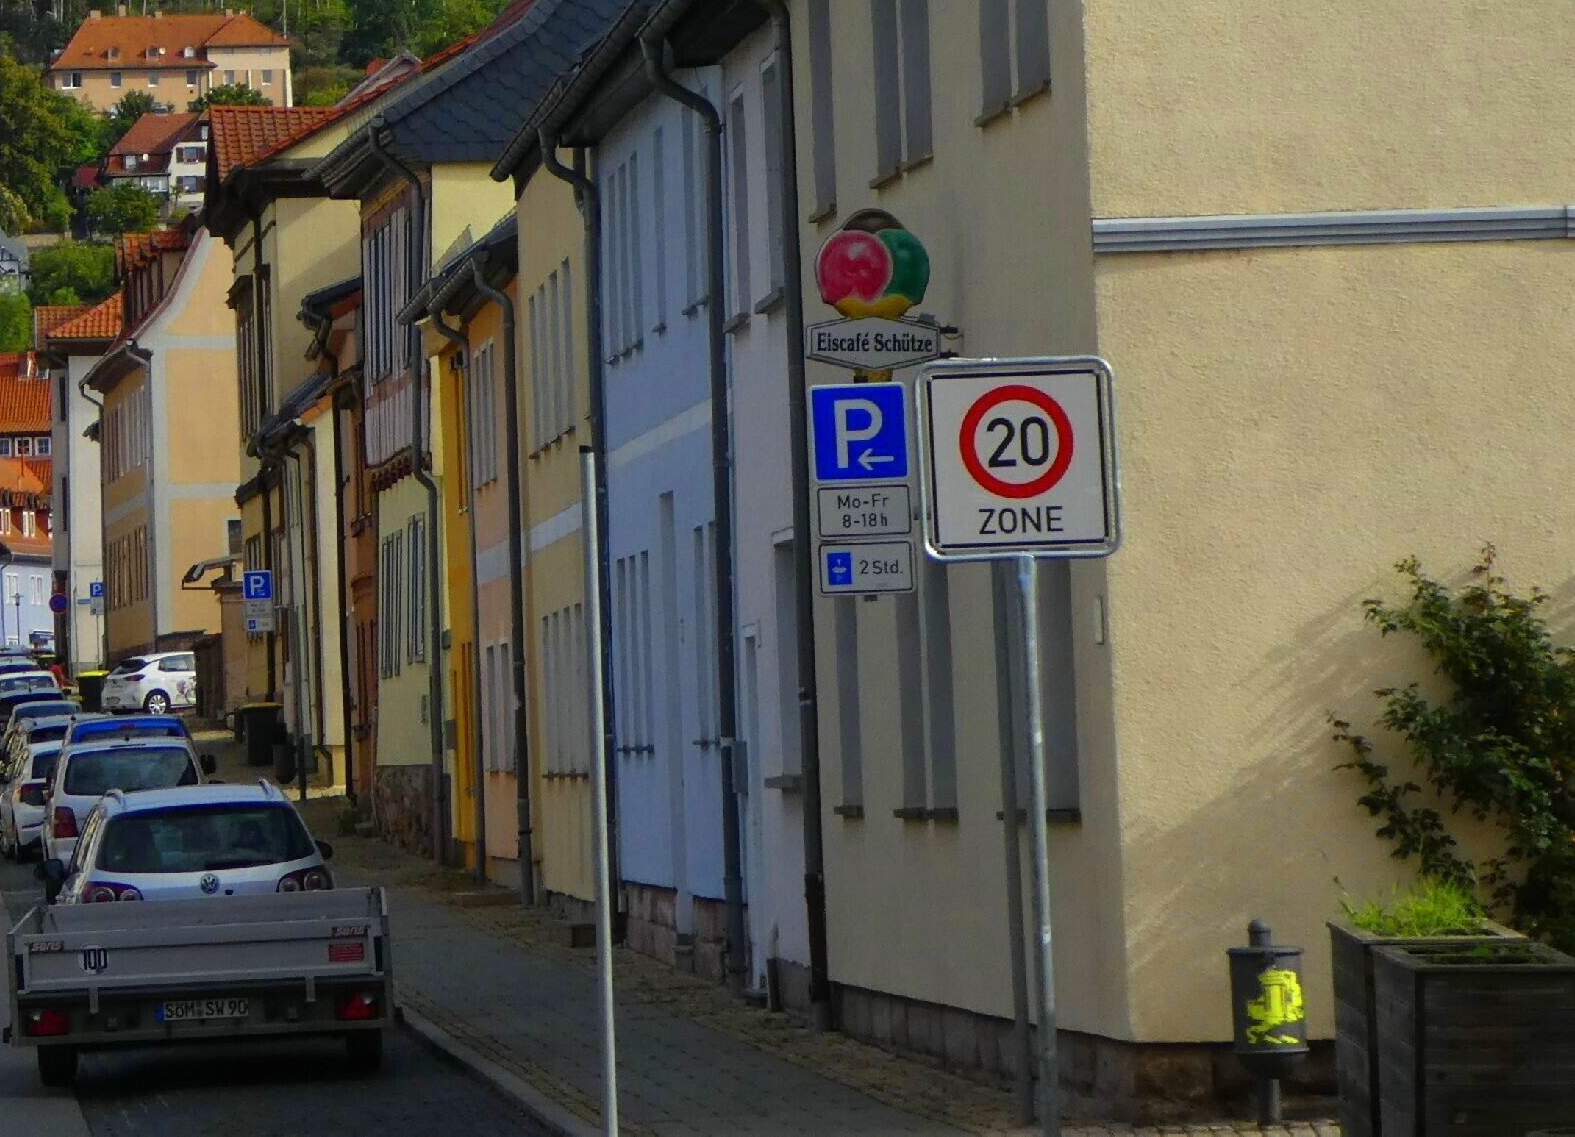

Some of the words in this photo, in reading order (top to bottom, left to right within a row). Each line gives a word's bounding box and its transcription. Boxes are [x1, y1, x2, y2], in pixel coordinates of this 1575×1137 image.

[817, 332, 869, 352] Eiscafé
[873, 332, 933, 352] Schütze
[834, 398, 883, 469] P
[986, 416, 1050, 468] 20
[837, 493, 889, 510] Mo-Fr
[978, 505, 1064, 535] ZONE
[250, 575, 264, 597] P
